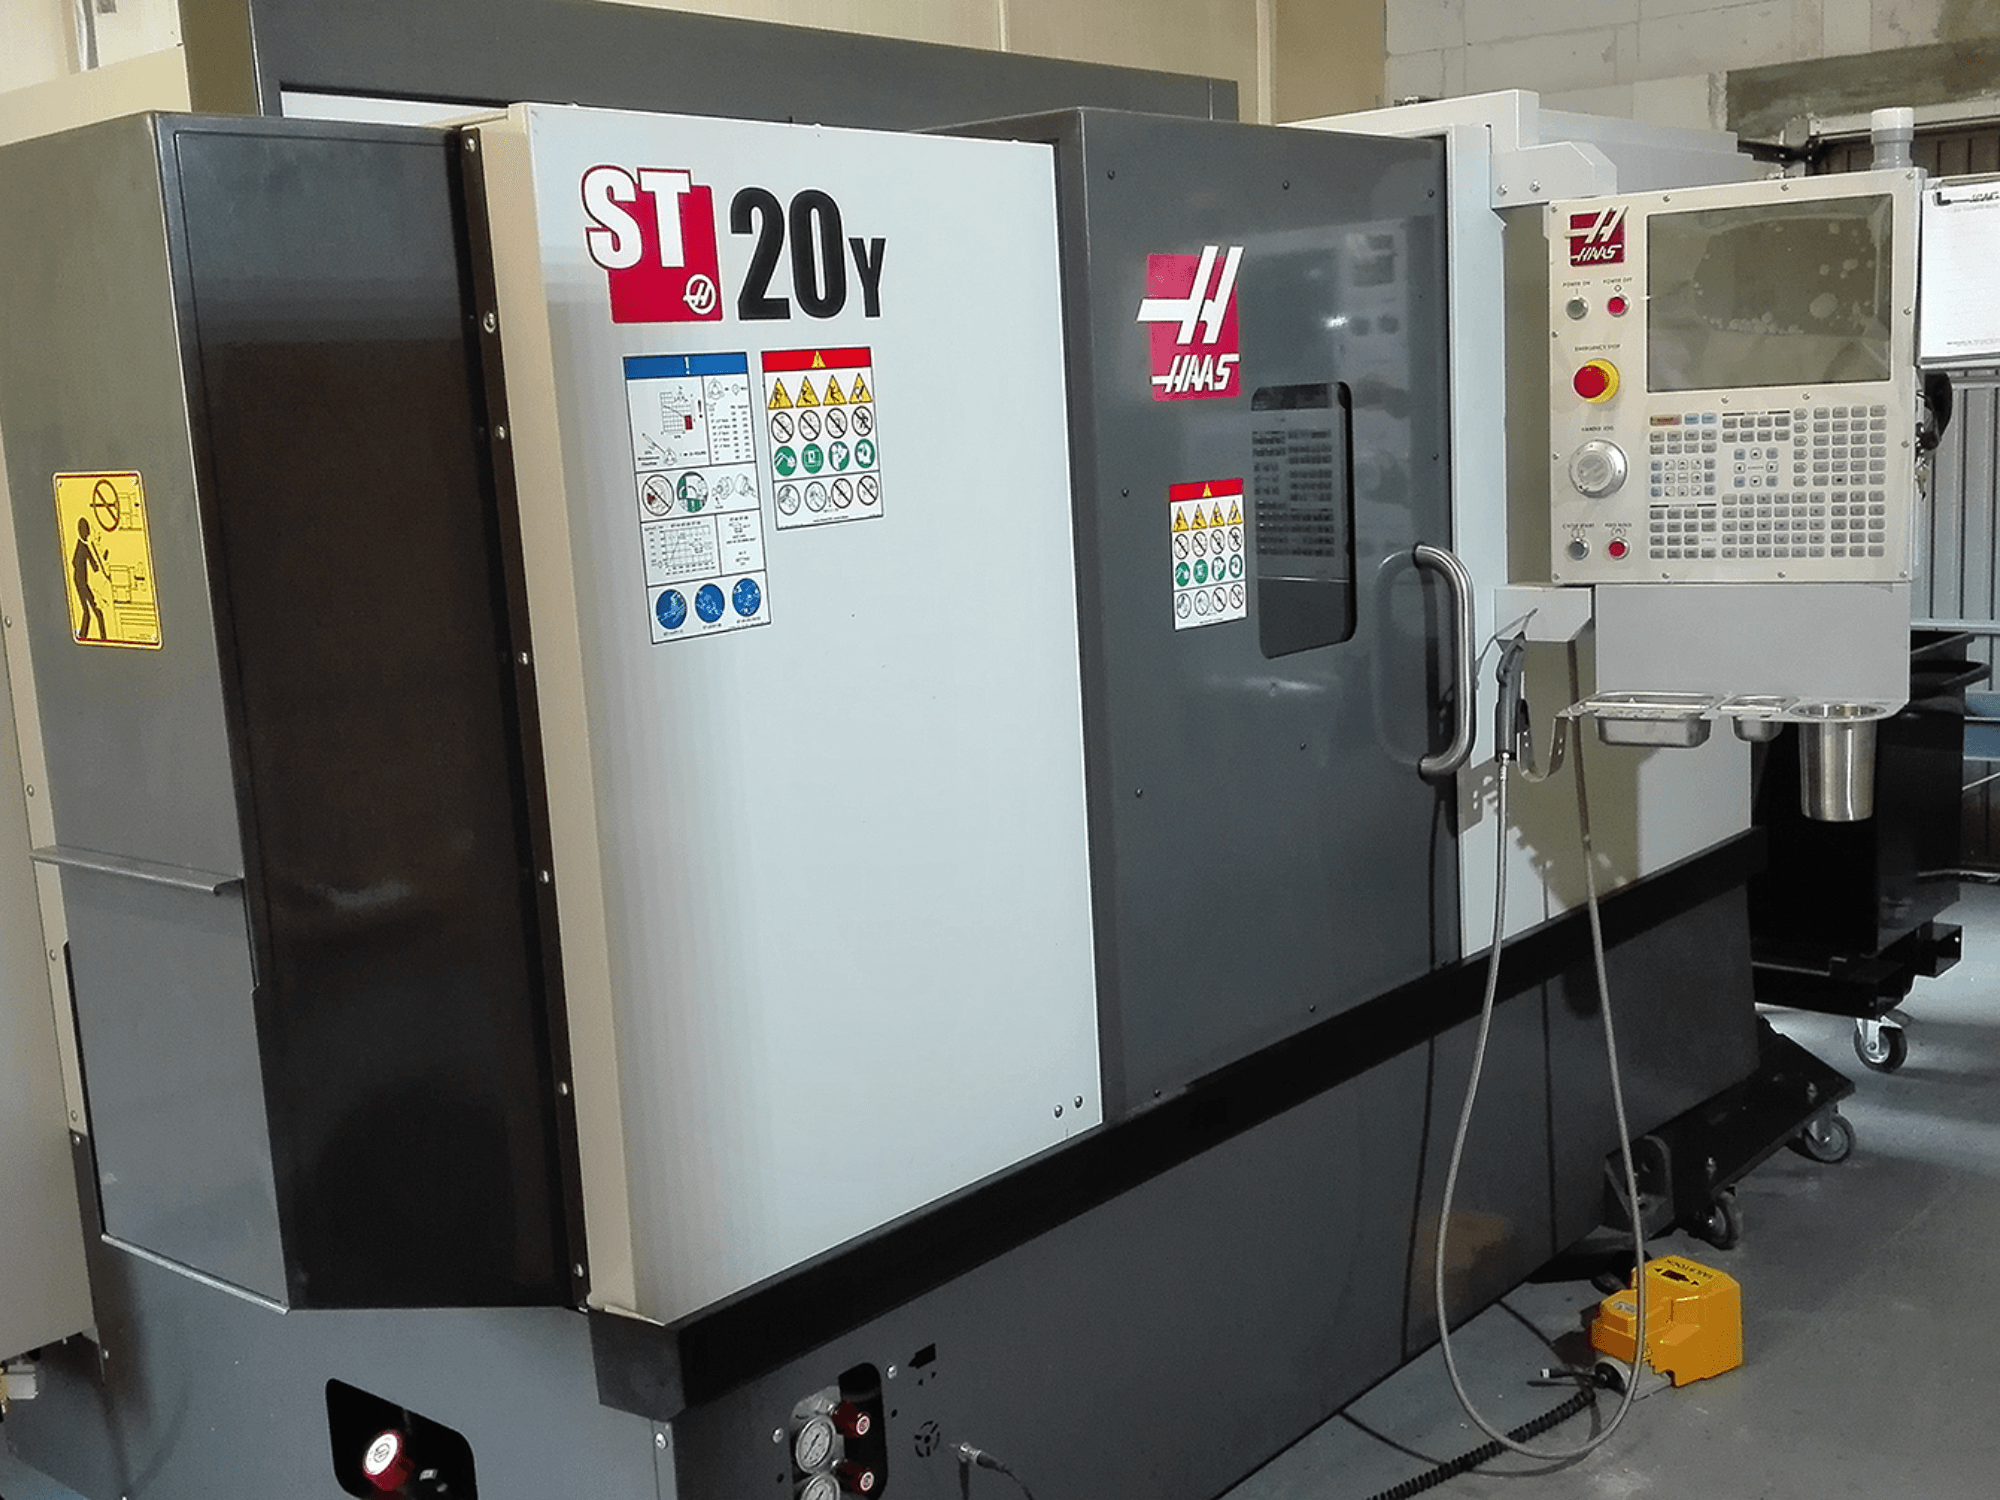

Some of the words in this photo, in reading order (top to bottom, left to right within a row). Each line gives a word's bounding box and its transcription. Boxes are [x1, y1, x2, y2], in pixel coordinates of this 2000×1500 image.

[581, 165, 691, 270] ST
[1570, 245, 1622, 262] HAAS
[1574, 344, 1607, 352] EMERGENCY
[1151, 353, 1241, 393] HAAS
